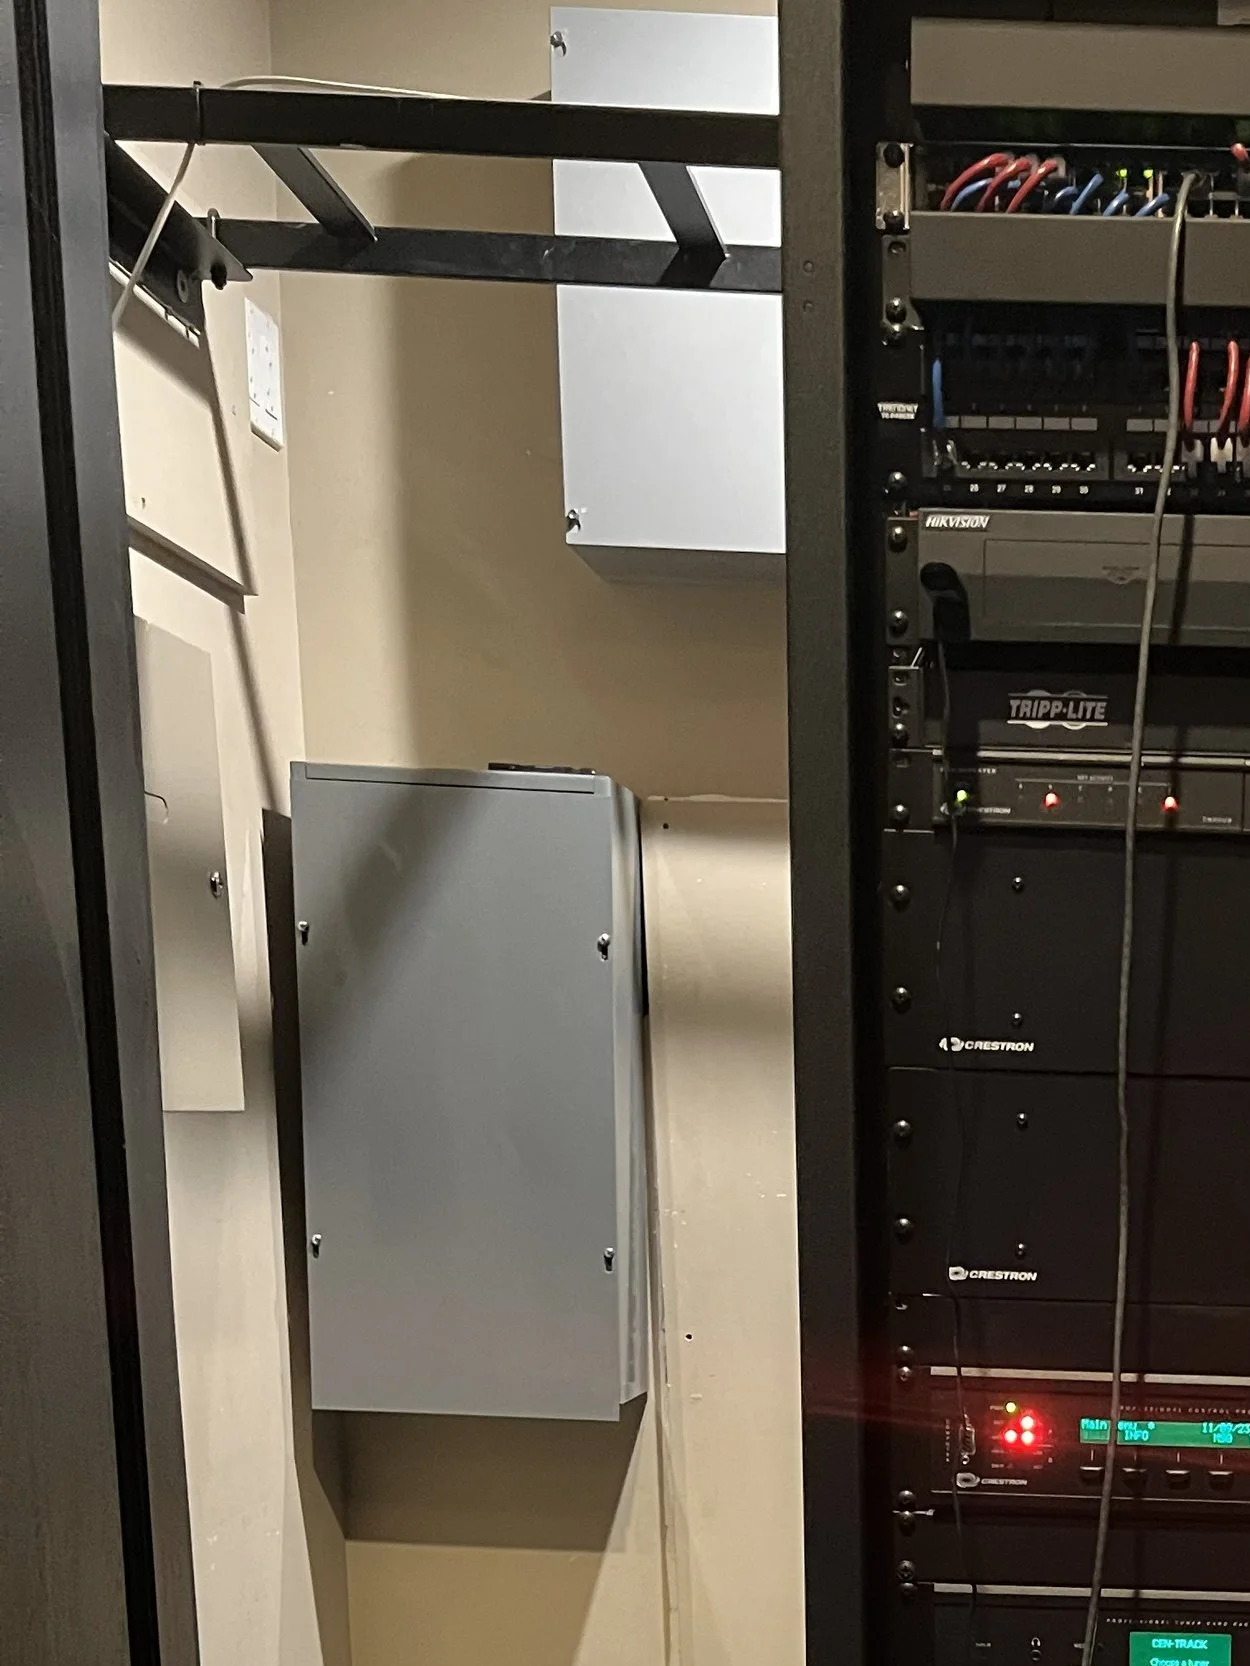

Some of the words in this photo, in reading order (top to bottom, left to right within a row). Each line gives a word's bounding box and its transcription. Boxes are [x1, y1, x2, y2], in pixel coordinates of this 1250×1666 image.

[925, 515, 990, 528] HIKVISION
[964, 1040, 1035, 1052] CRESTRON
[969, 1270, 1038, 1281] CRESTRON
